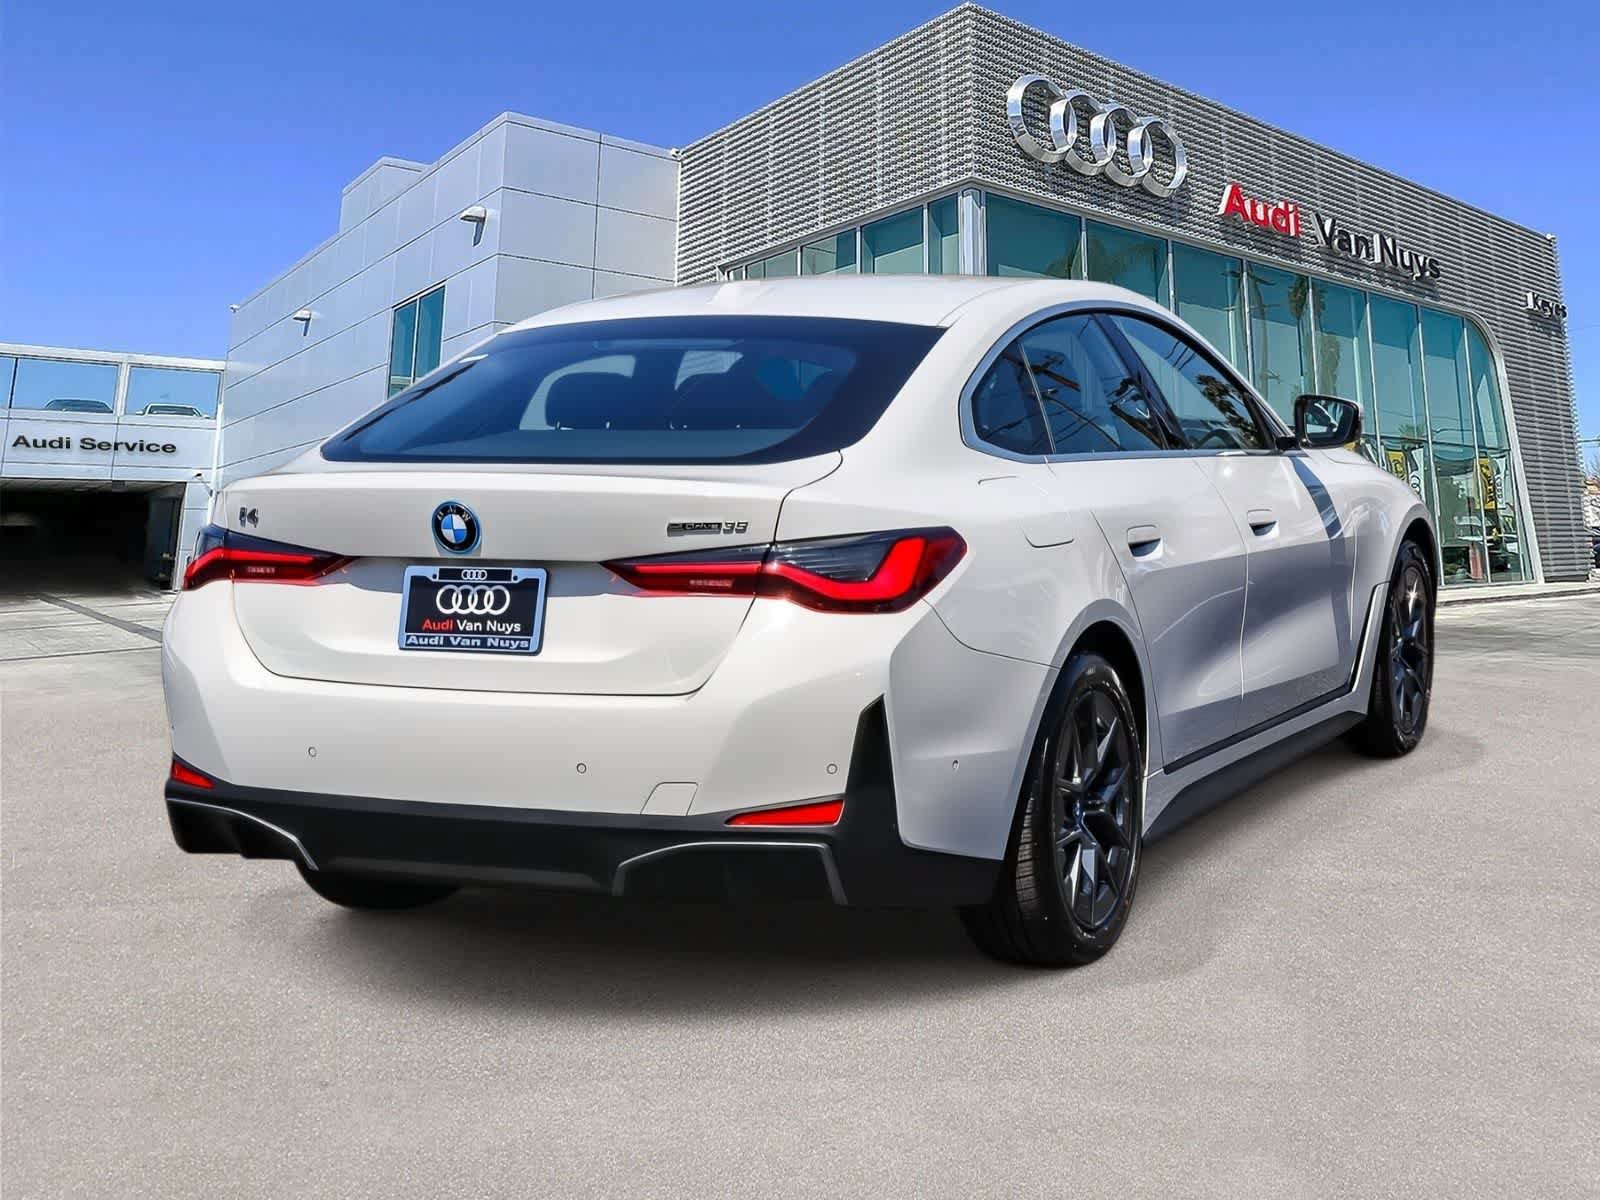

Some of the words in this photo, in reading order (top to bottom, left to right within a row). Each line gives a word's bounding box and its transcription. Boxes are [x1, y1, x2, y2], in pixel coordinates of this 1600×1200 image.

[1218, 182, 1301, 238] Audi
[1311, 212, 1373, 264] Van
[1372, 233, 1441, 280] Nuys
[1525, 291, 1568, 318] Keyes
[12, 435, 71, 450] Audi
[79, 437, 177, 454] Service
[422, 618, 454, 632] Audi
[456, 619, 483, 633] Van
[486, 620, 522, 635] Nuys
[406, 635, 444, 646] Audi
[449, 636, 481, 647] Van
[486, 637, 530, 649] Nuys
